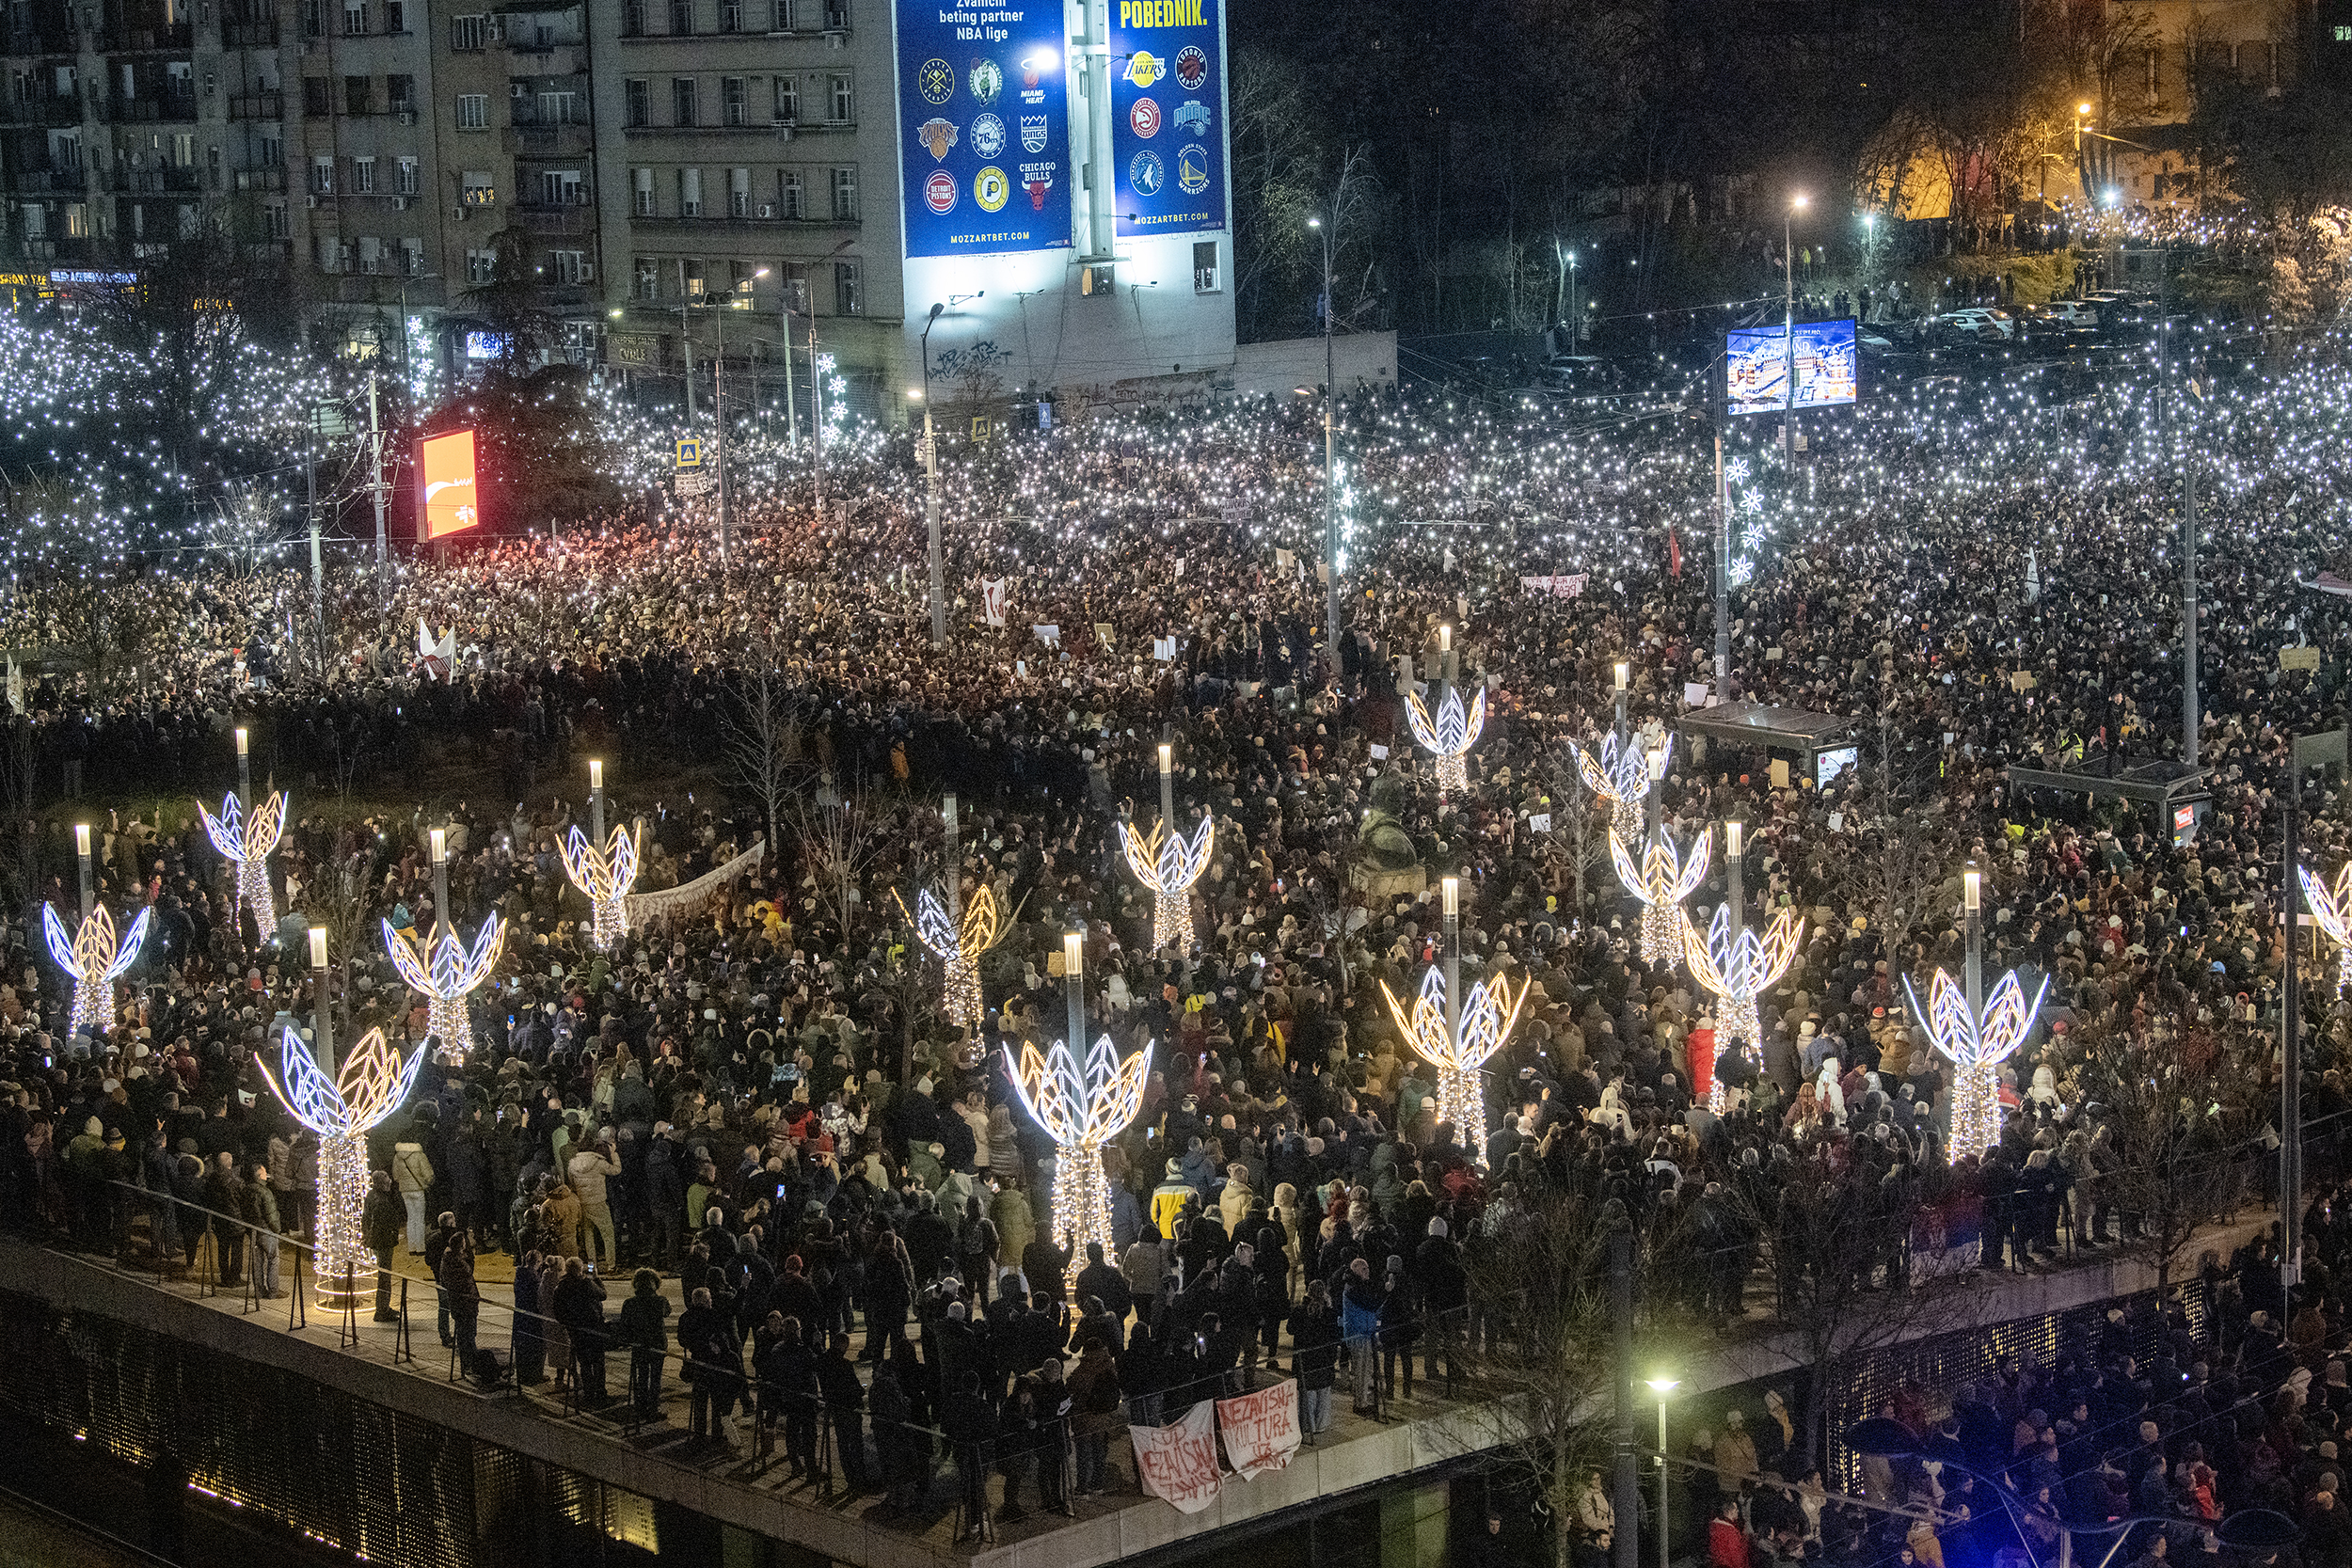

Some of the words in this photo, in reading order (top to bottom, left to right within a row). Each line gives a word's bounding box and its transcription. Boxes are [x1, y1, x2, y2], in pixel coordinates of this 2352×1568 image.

[940, 10, 977, 25] beting
[981, 10, 1024, 24] partner
[1120, 0, 1207, 28] POBEDNIK.
[957, 27, 982, 40] NBA
[986, 26, 1009, 42] lige
[1178, 49, 1204, 64] TORONTO
[1127, 61, 1163, 77] LAKERS
[1178, 71, 1204, 87] RAPTORS
[1025, 94, 1045, 103] HEAT
[1022, 131, 1046, 139] KINGS
[1019, 162, 1056, 172] CHICAGO
[1025, 171, 1051, 182] BULLS
[1178, 178, 1210, 195] WARRIORS
[1135, 213, 1208, 225] MOZZARTBET.COM
[950, 231, 1029, 244] MOZZARTBET.COM
[1235, 1410, 1294, 1449] KULTURA
